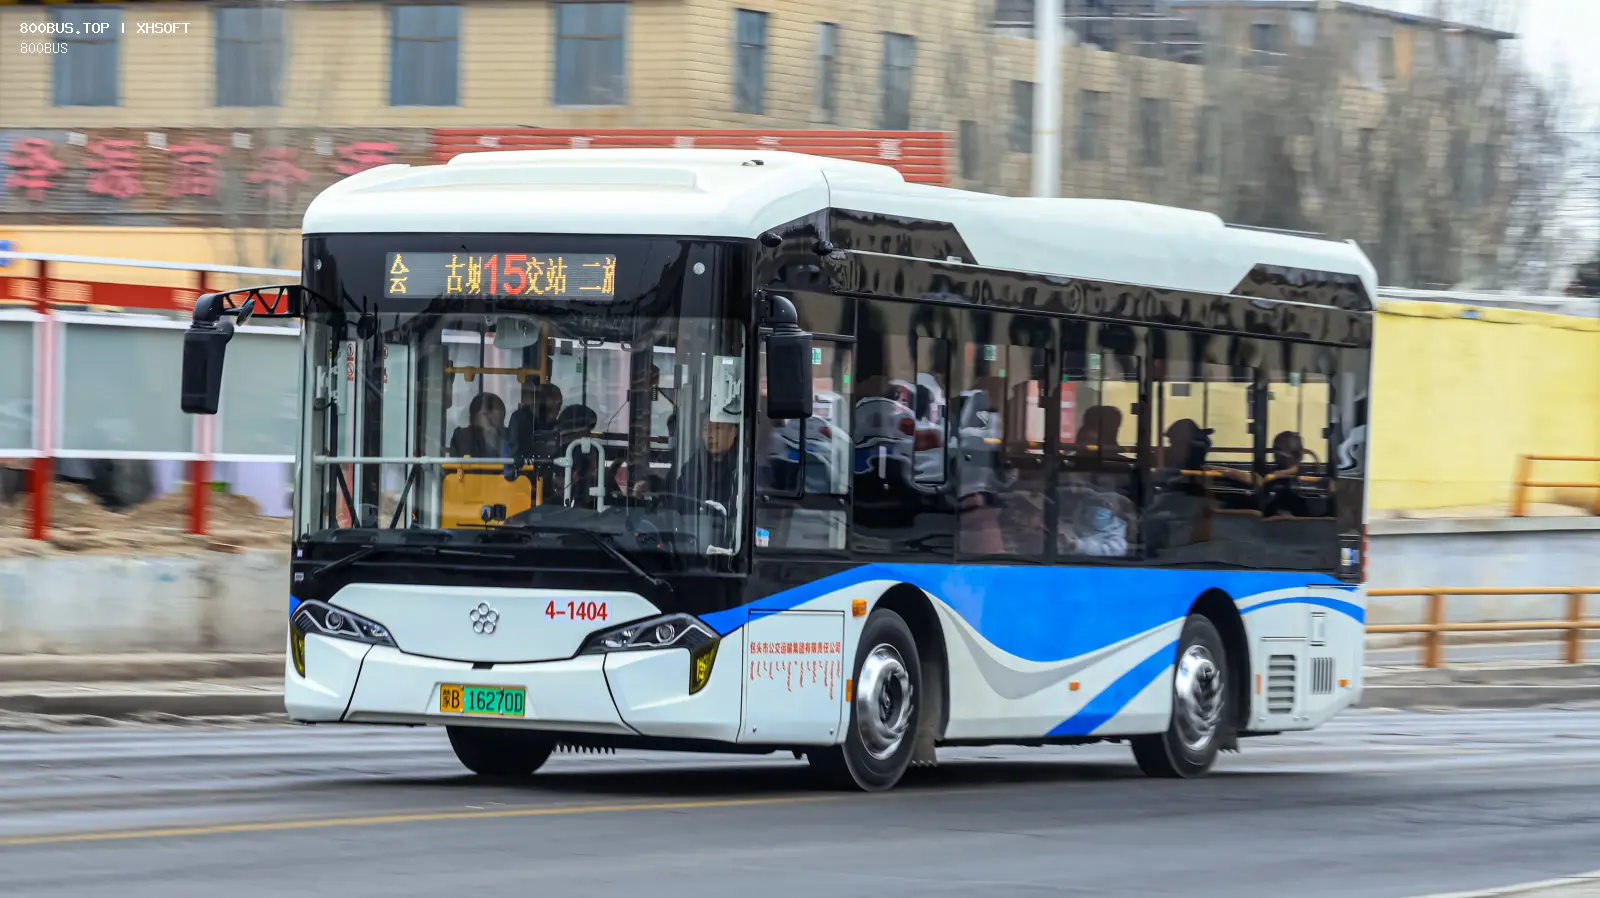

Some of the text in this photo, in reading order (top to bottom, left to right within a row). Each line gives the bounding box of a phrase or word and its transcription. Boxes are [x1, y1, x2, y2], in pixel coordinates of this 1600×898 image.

[484, 254, 527, 295] 15
[545, 599, 608, 621] 4-1404
[469, 690, 523, 712] 16270D
